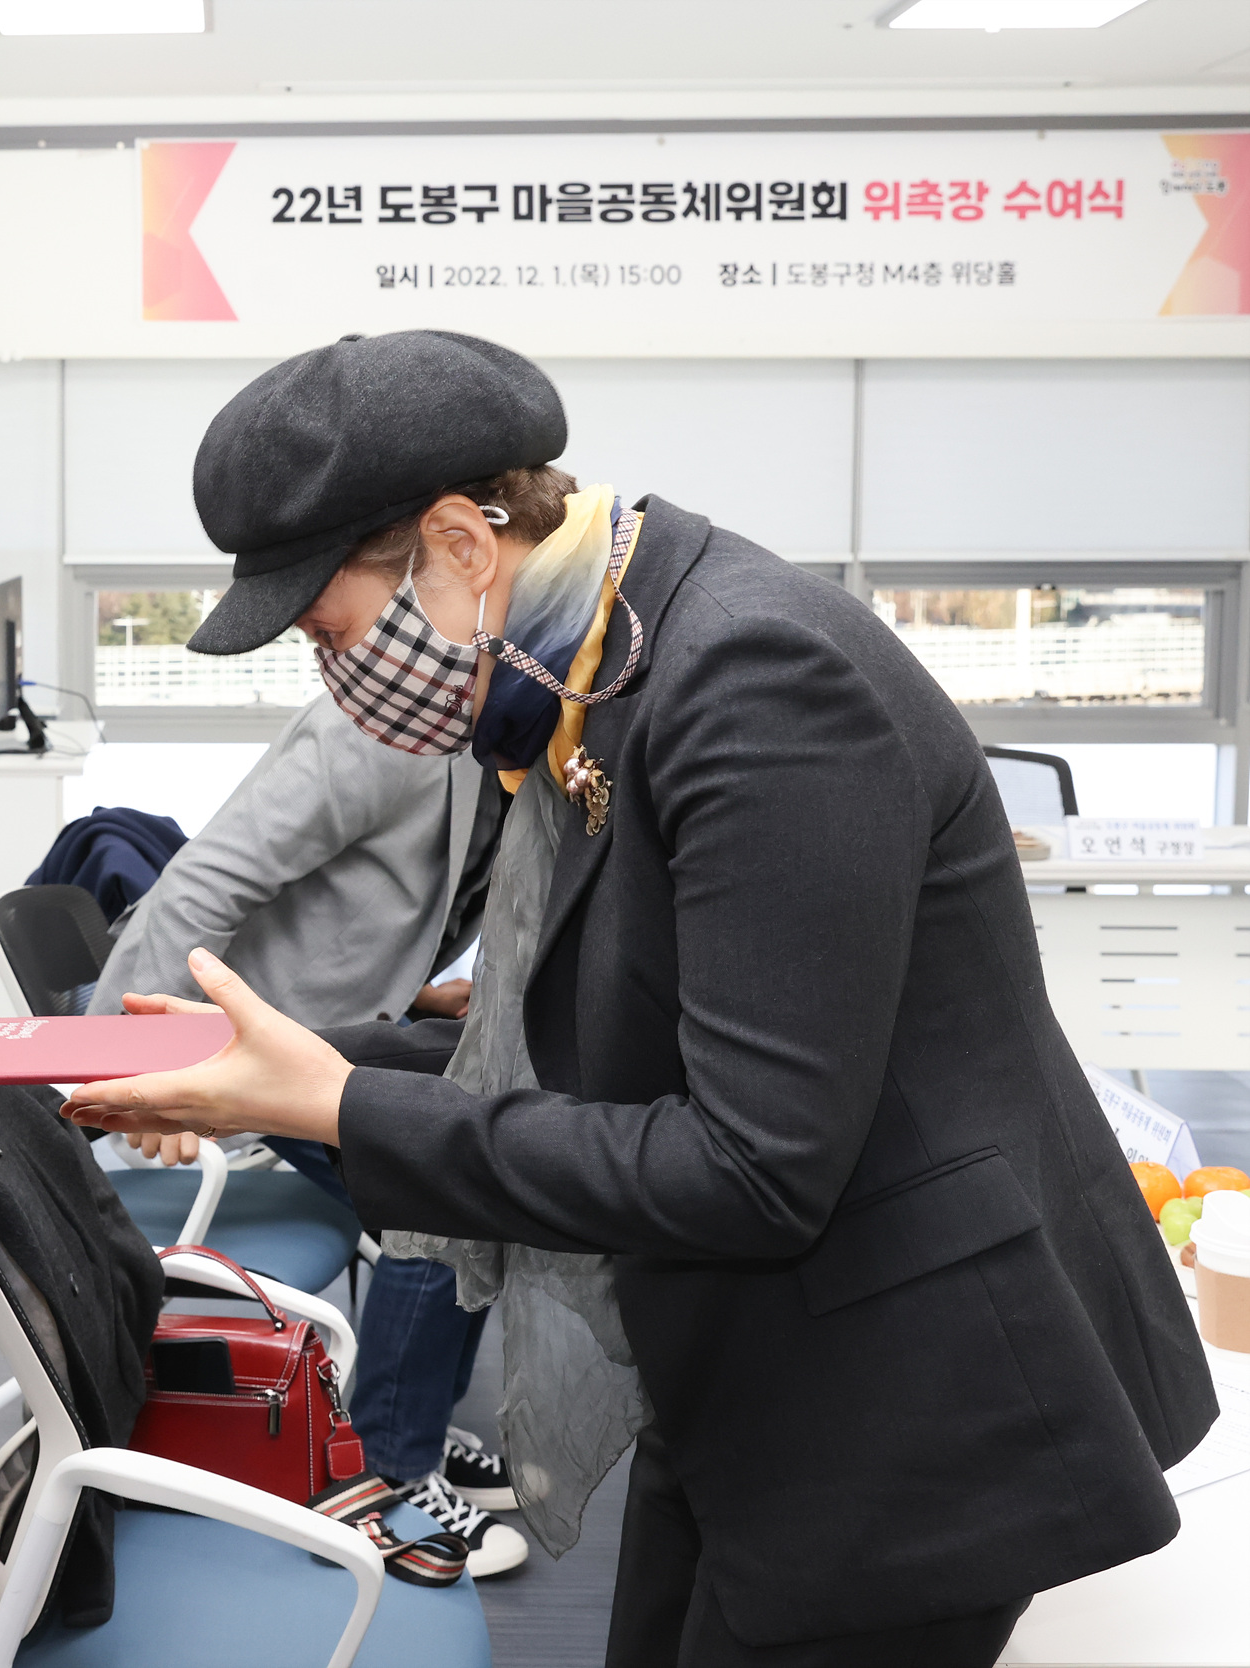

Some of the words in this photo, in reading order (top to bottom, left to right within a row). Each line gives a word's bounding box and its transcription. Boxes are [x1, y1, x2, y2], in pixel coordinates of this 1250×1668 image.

[272, 184, 363, 224] 22년
[378, 184, 500, 225] 도봉구
[513, 181, 848, 224] 마을공동체위원회
[863, 179, 990, 222] 위촉장
[1003, 179, 1125, 220] 수여식
[376, 263, 418, 289] 일시
[443, 265, 506, 287] 2022.
[516, 265, 543, 287] 12.
[619, 264, 682, 286] 15:00
[718, 262, 762, 287] 장소
[787, 262, 875, 286] 도봉구청
[882, 262, 942, 286] M4층
[951, 260, 1017, 286] 위당홀
